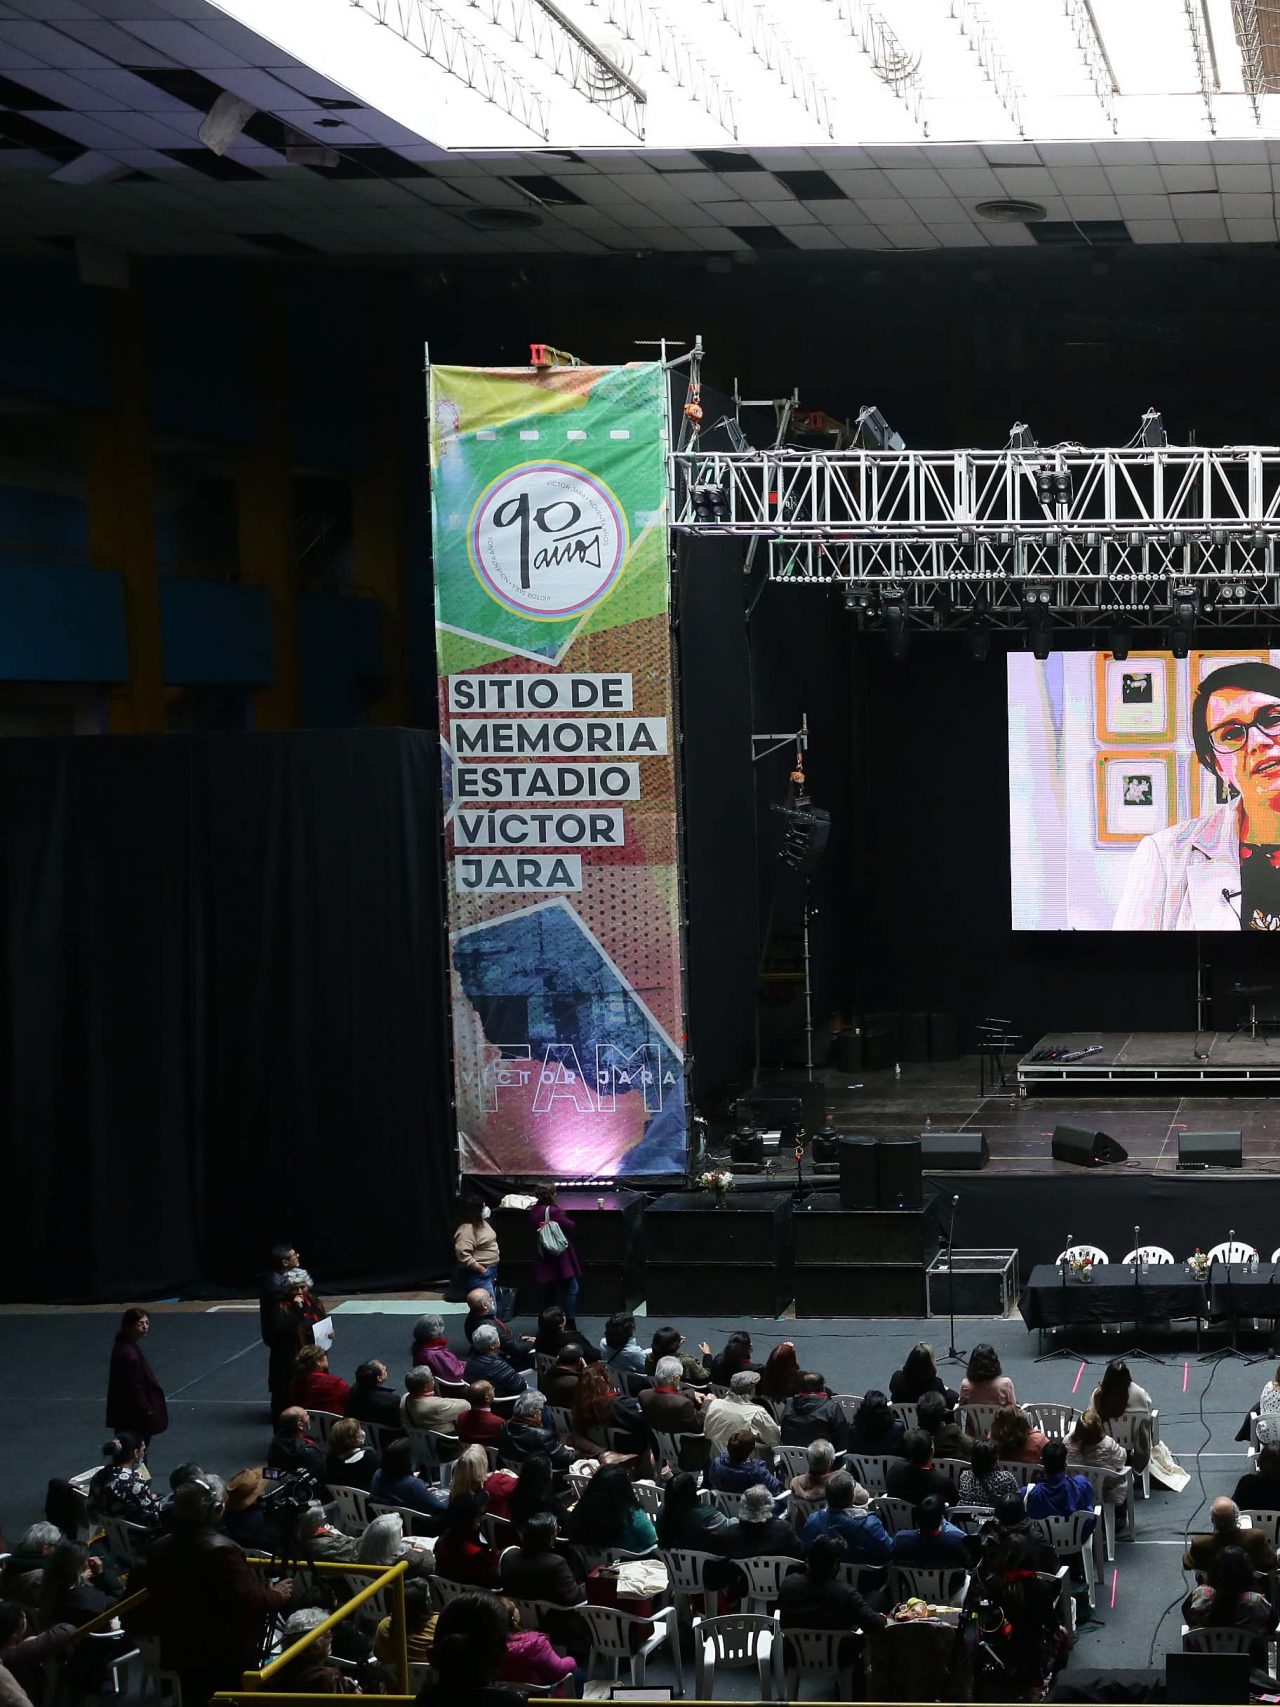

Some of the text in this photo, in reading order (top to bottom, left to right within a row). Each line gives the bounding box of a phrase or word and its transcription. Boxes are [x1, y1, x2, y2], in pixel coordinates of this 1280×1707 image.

[493, 493, 581, 589] 90
[454, 678, 623, 709] SITIO DE
[455, 722, 658, 753] MEMORIA
[457, 766, 631, 797] ESTADIO
[457, 808, 616, 844] VÍCTOR
[461, 858, 575, 888] JARA
[478, 1043, 663, 1113] FAM
[599, 1070, 677, 1086] JARA
